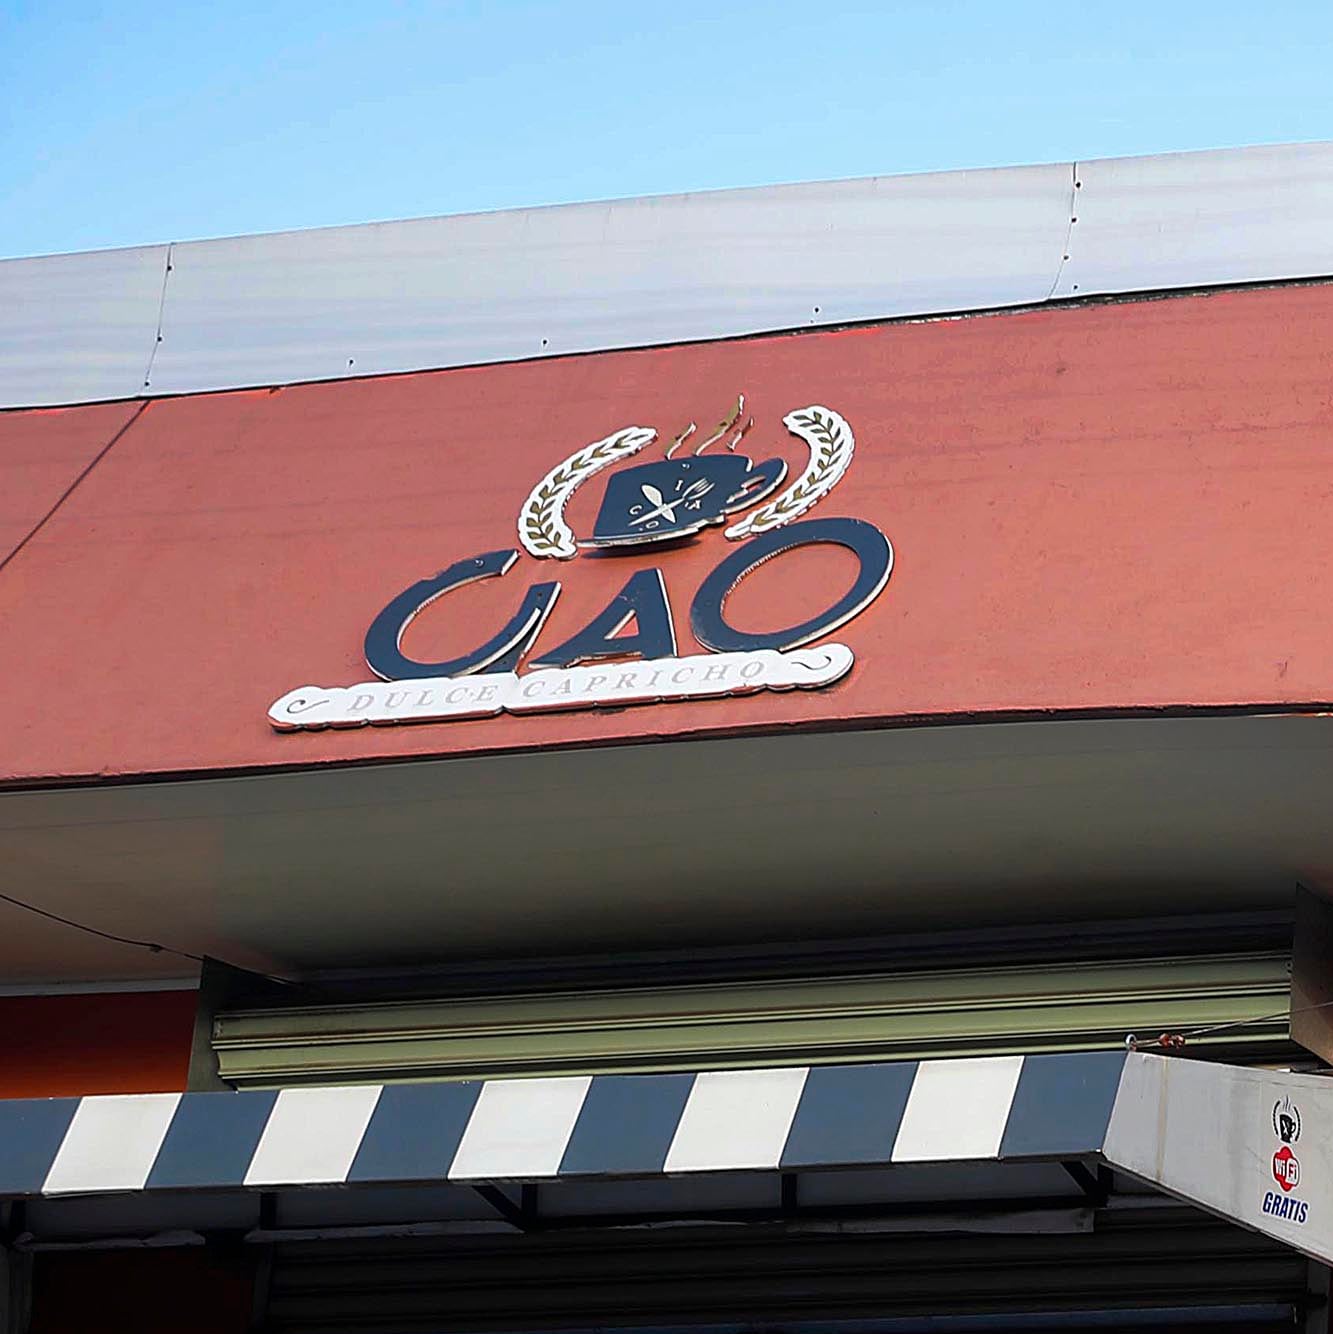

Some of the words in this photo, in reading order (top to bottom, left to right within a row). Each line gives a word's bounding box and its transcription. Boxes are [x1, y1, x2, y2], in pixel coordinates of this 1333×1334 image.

[363, 517, 895, 682] CIAO
[347, 684, 500, 713] DULCE
[521, 658, 768, 700] CAPRICHO
[1262, 1191, 1309, 1223] GRATIS
